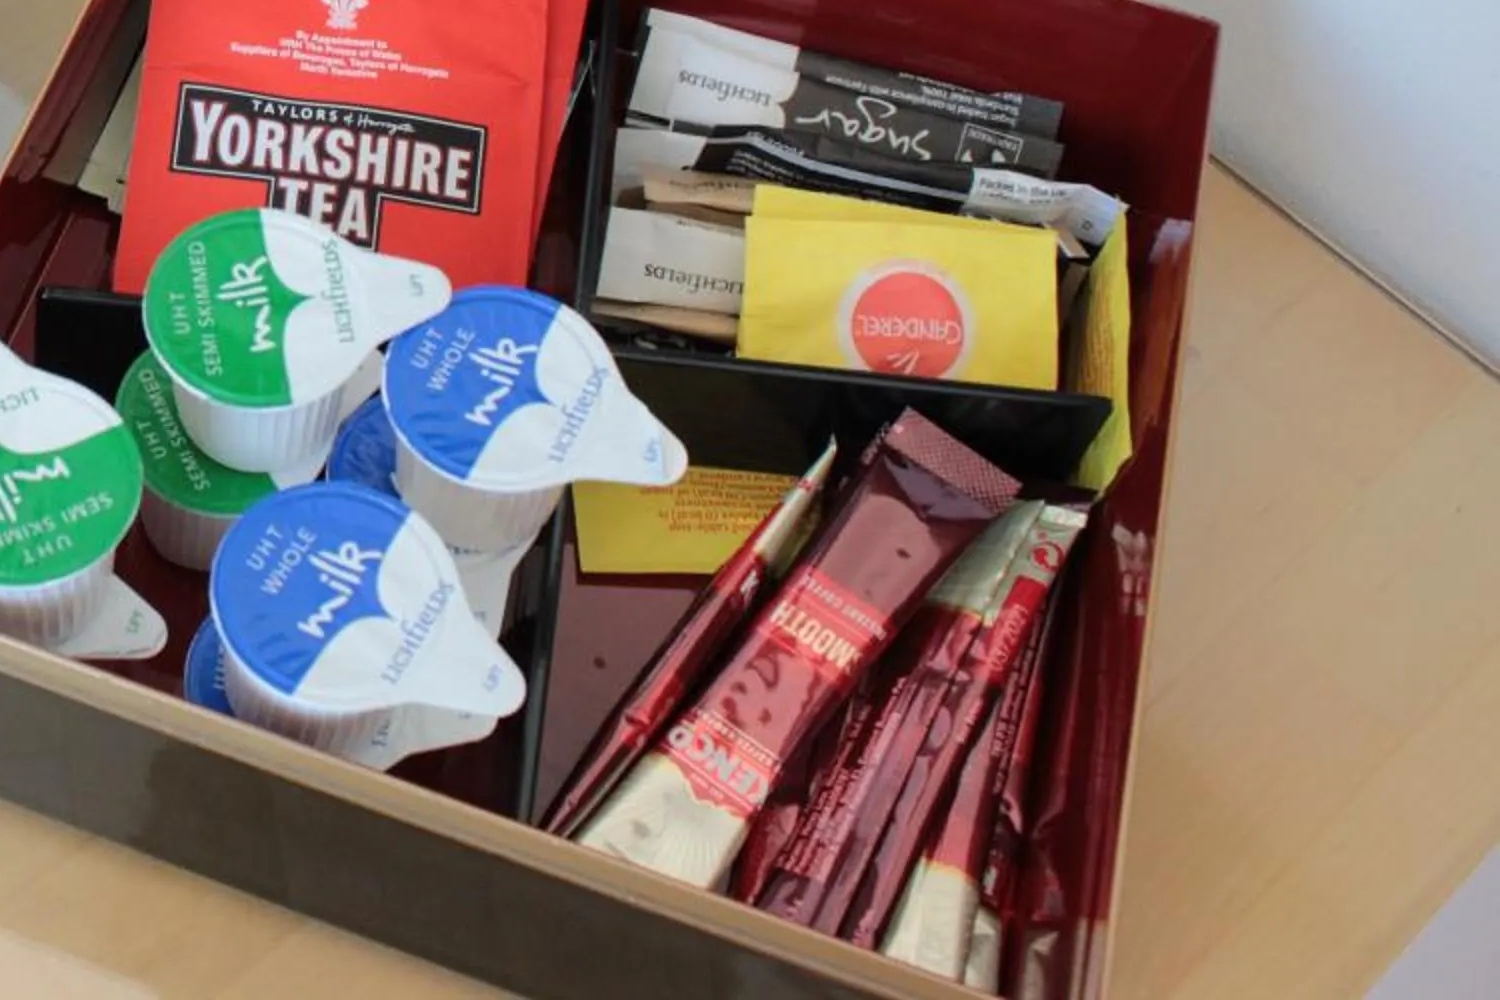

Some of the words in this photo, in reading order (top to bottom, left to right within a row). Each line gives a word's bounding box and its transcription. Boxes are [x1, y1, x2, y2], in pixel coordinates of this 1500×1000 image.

[251, 99, 338, 122] TAYLORS
[795, 95, 932, 161] sugar
[187, 99, 473, 200] YORKSHIRE
[279, 178, 371, 241] TEA
[169, 291, 191, 335] UHT
[187, 240, 215, 328] SKIMMED
[215, 255, 277, 353] milk
[202, 330, 223, 377] SEMI
[411, 326, 444, 370] UHT
[426, 326, 476, 393] WHOLE
[856, 313, 963, 346] CANDEREL
[138, 369, 186, 448] SKIMMED
[464, 337, 538, 427] milk
[136, 419, 168, 460] UHT
[179, 449, 211, 492] SEMI
[61, 490, 114, 525] SEMI
[22, 534, 73, 566] UHT
[245, 523, 285, 572] UHT
[260, 527, 318, 596] WHOLE
[296, 540, 383, 640] milk
[668, 724, 770, 806] KENCO
